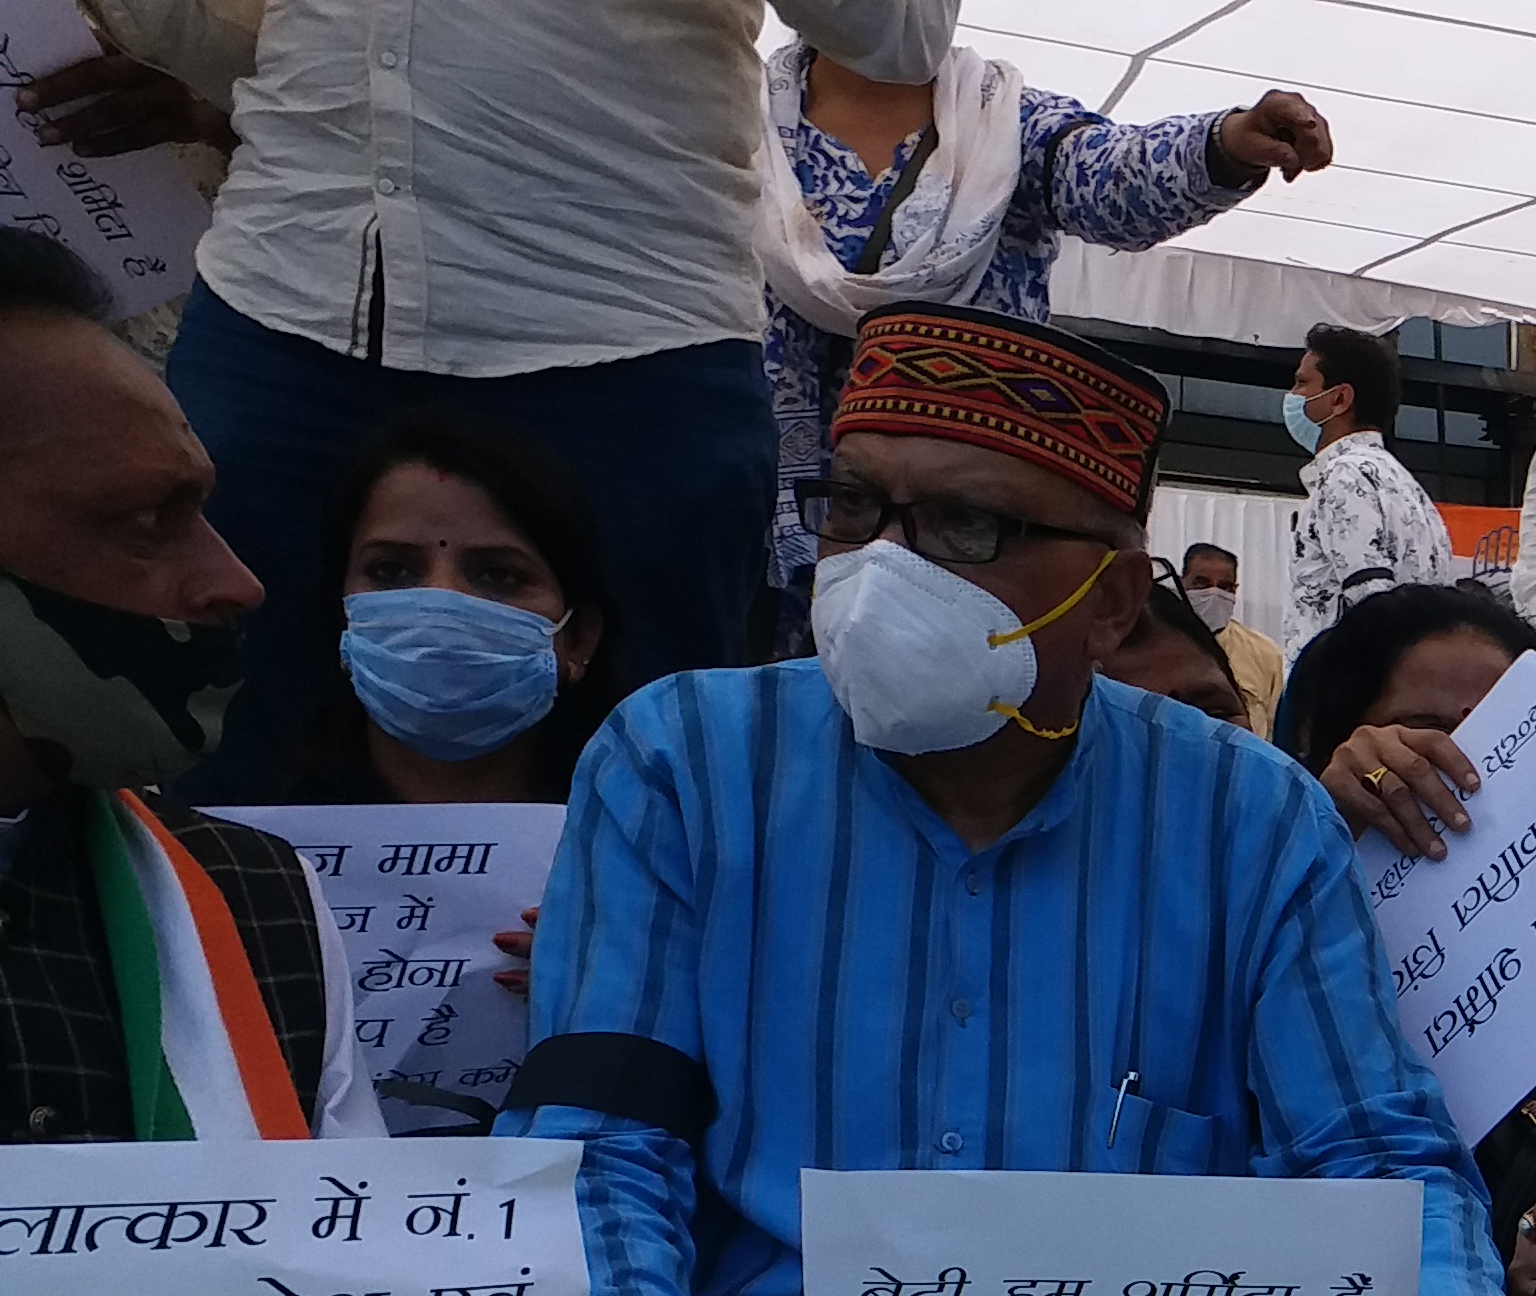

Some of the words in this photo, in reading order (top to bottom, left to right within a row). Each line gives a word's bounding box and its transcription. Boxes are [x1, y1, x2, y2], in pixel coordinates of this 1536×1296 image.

[378, 843, 498, 876] मामा
[396, 894, 436, 931] में
[358, 948, 472, 992] होना
[418, 1003, 460, 1047] है
[459, 1059, 521, 1088] कमे
[312, 1177, 372, 1242] में
